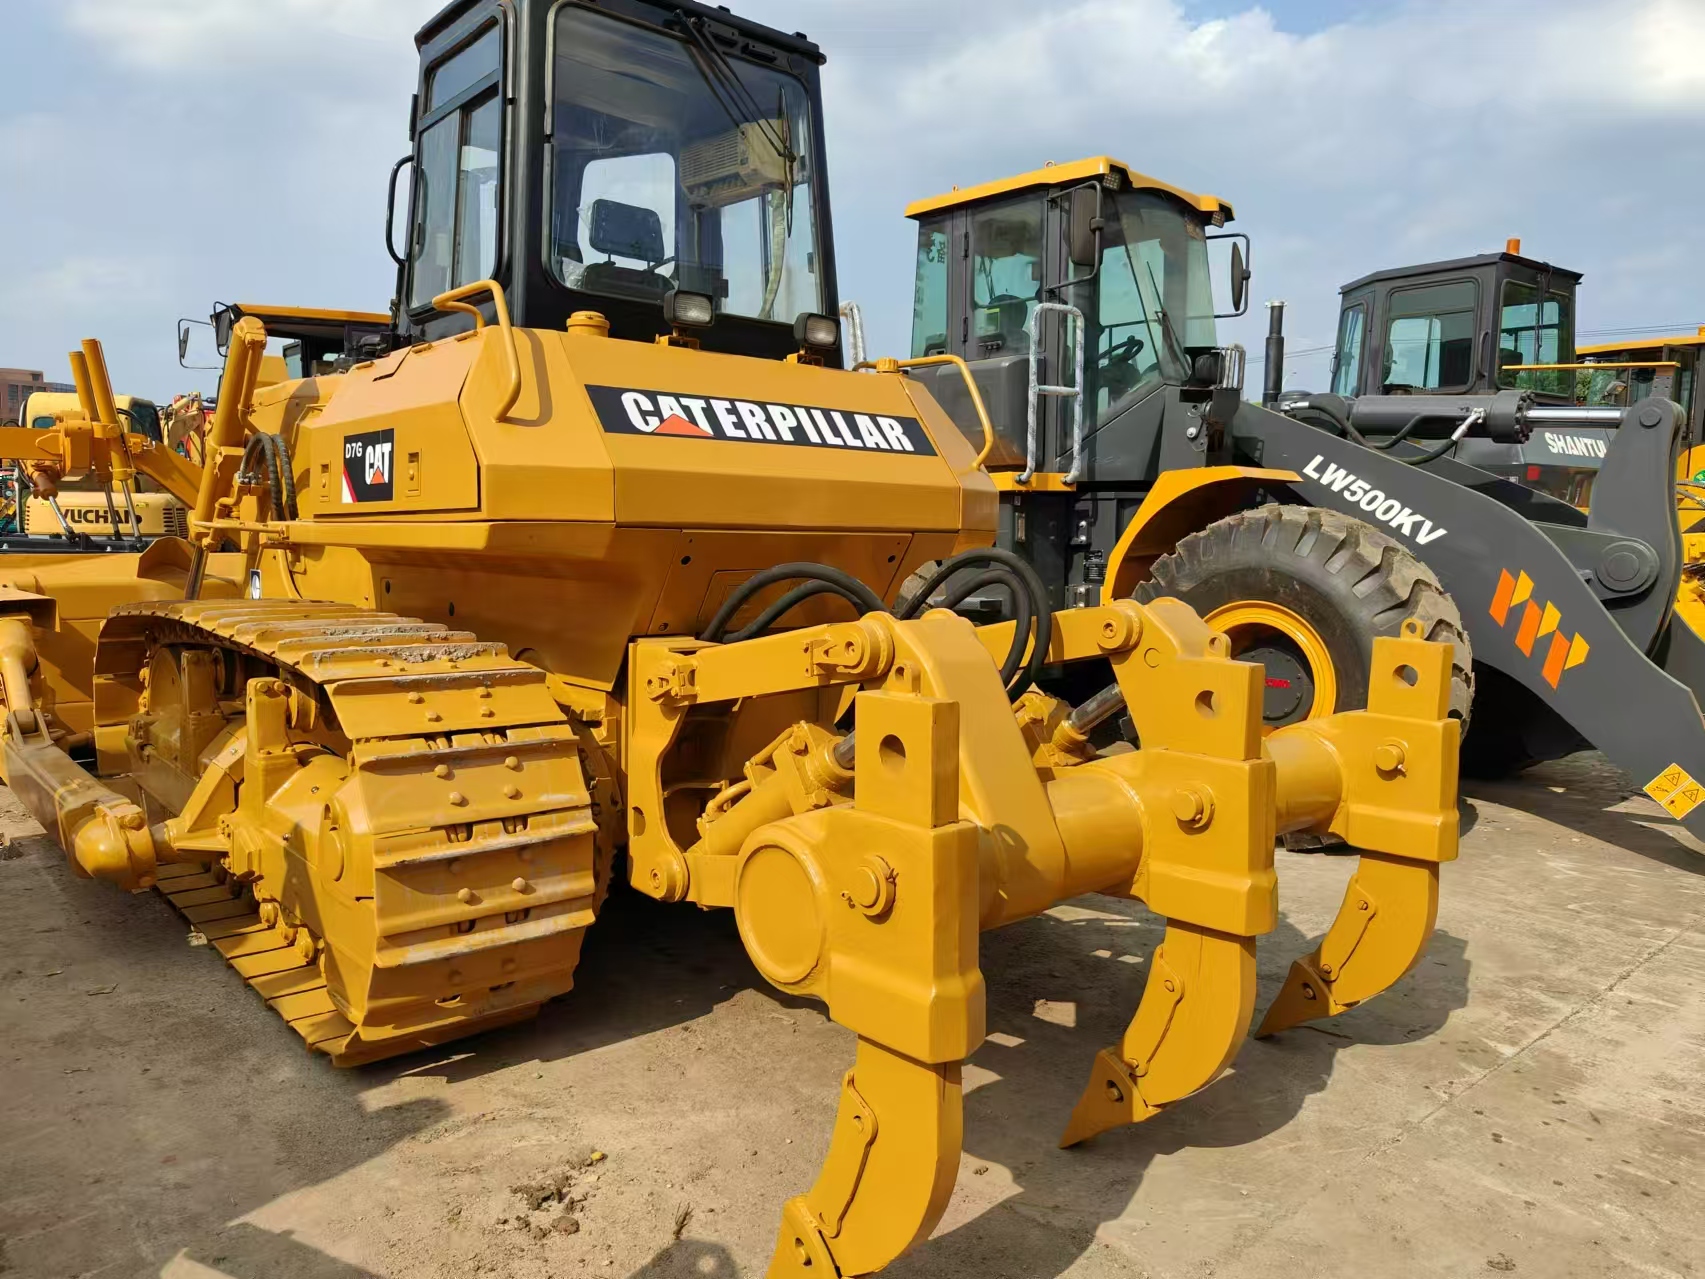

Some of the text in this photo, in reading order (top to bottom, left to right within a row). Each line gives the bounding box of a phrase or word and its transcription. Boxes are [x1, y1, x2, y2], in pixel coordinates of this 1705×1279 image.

[620, 391, 915, 452] CATERPILLAR
[345, 441, 363, 459] D7G
[365, 442, 392, 485] CAT
[1302, 454, 1448, 545] LW500KV
